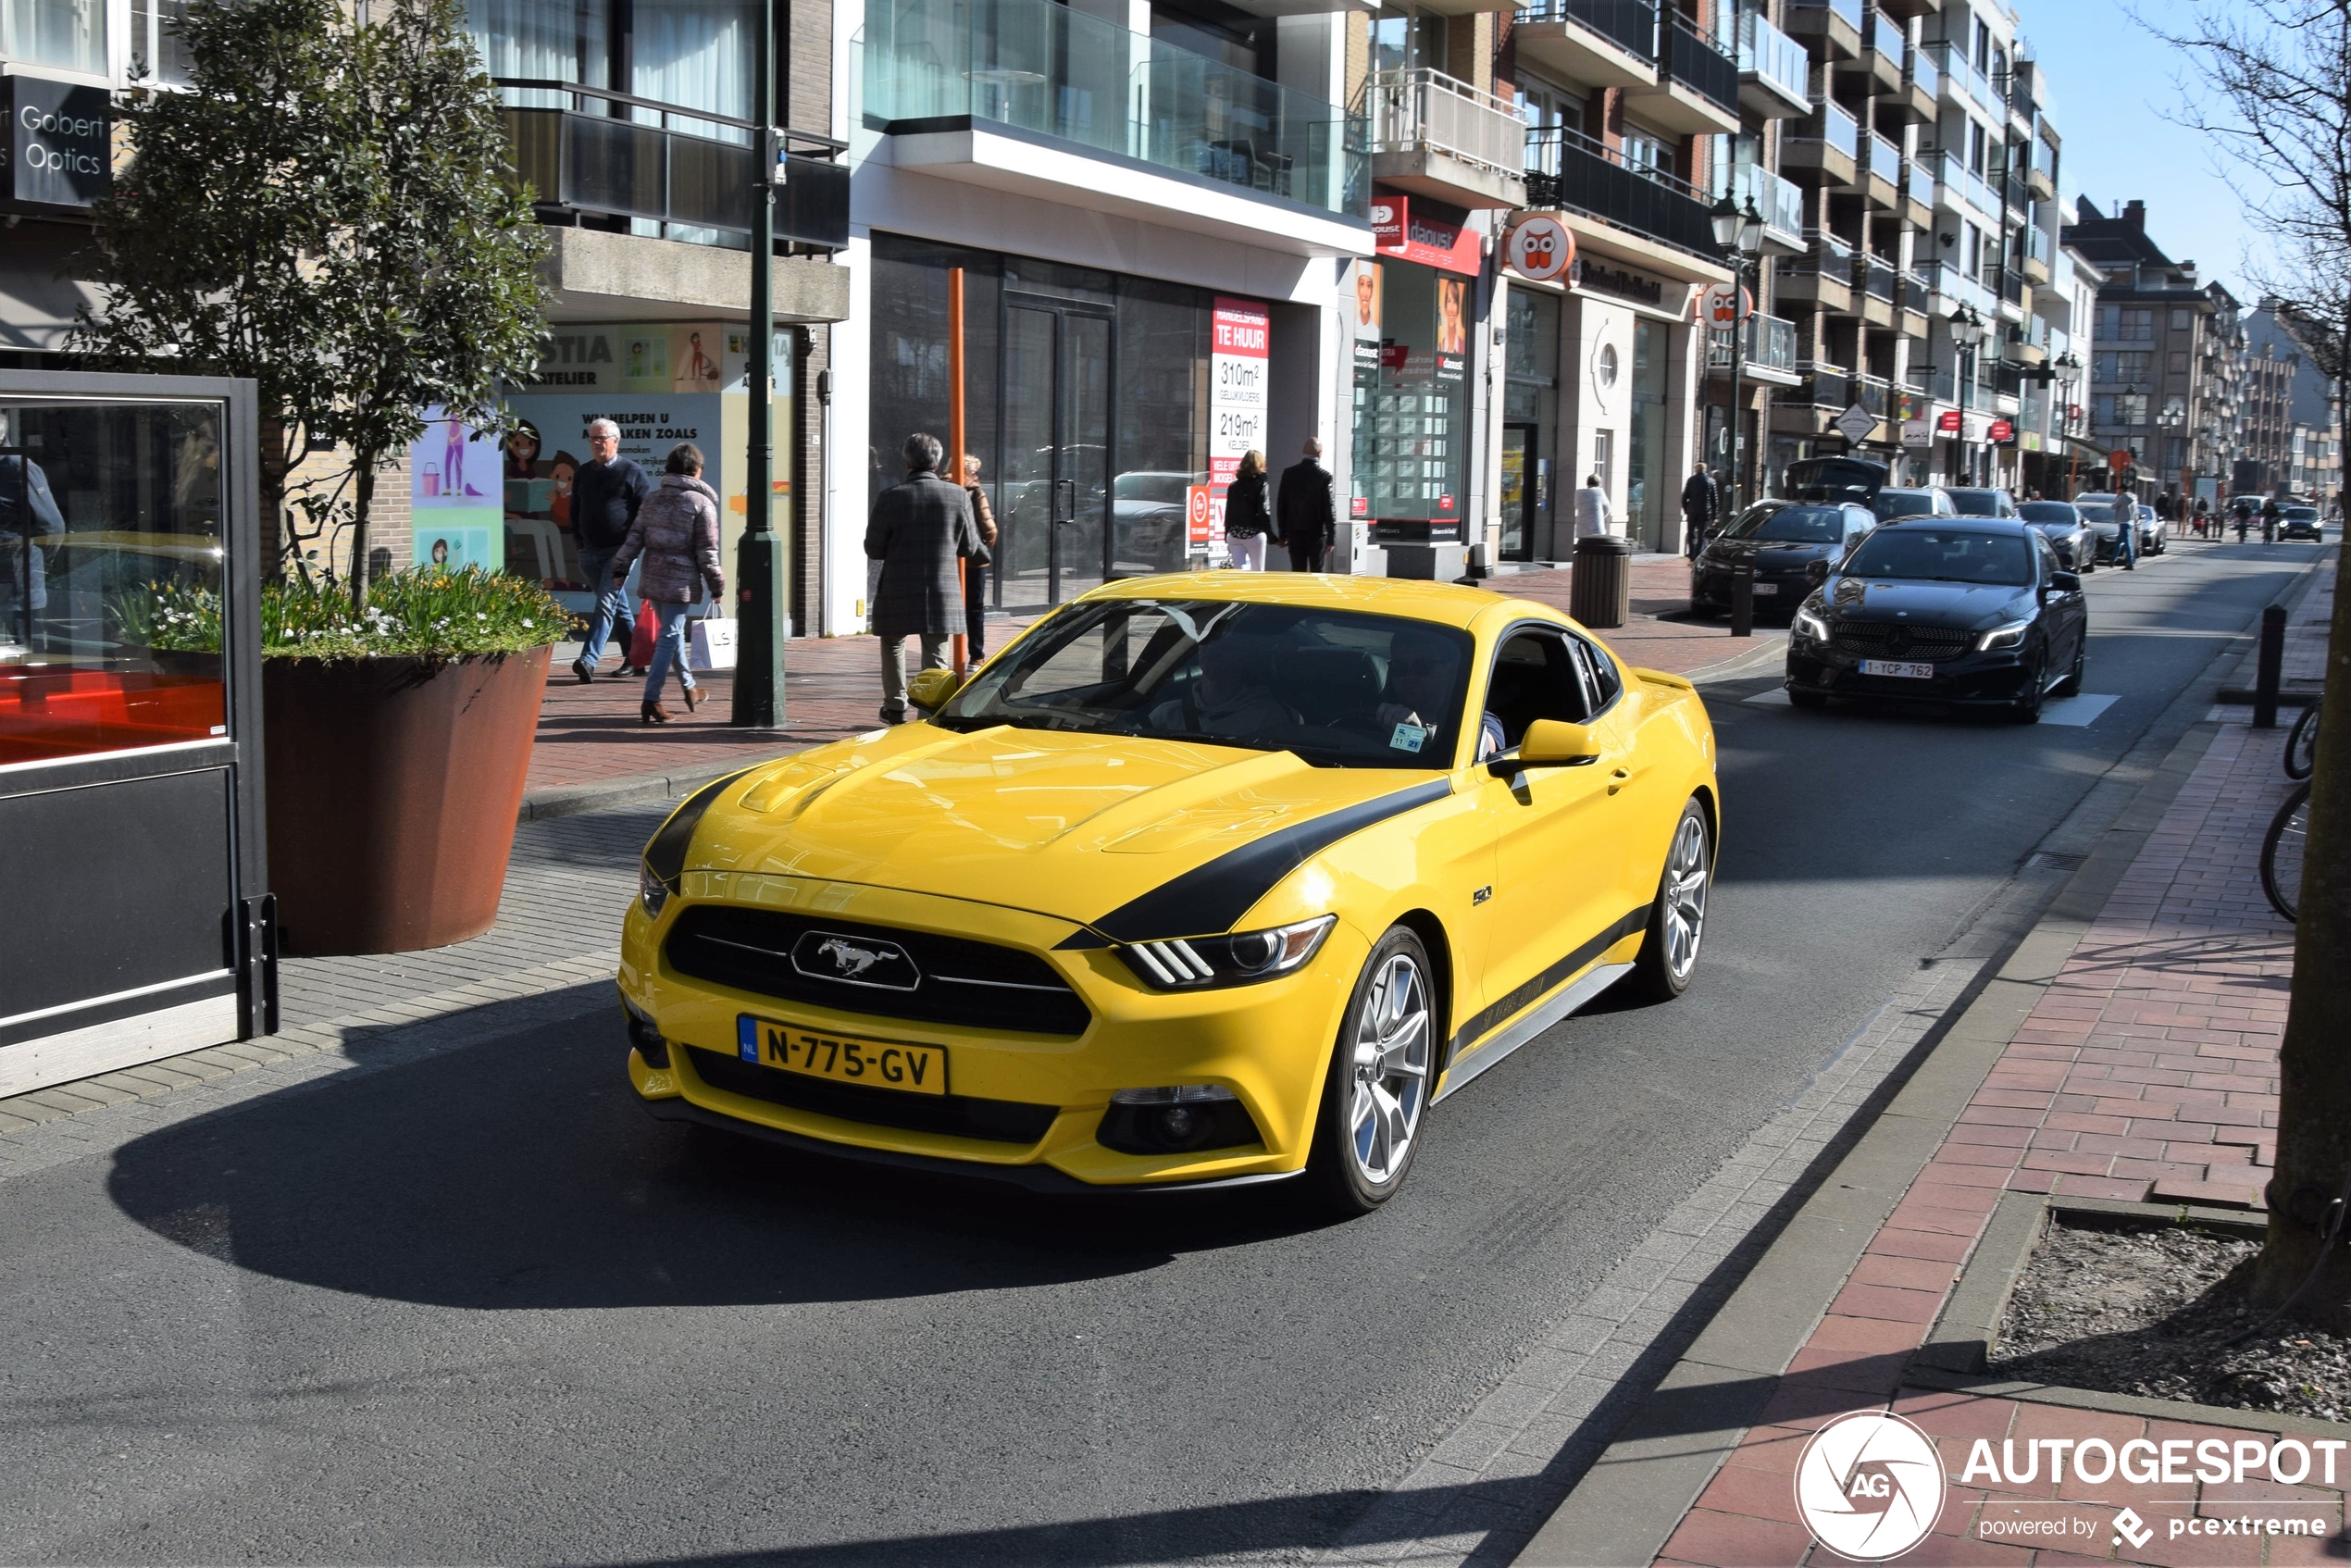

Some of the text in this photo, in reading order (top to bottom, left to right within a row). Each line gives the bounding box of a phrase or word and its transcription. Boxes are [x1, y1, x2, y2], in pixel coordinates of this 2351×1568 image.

[20, 106, 105, 138] Gobert
[26, 143, 100, 174] Optics
[1372, 225, 1400, 233] oust
[1410, 220, 1453, 249] daoust
[1216, 324, 1265, 350] TE HUUR
[538, 335, 613, 364] STIA
[660, 414, 669, 424] U
[621, 428, 697, 440] AKEN ZOALS
[1868, 662, 1931, 677] 1-YCP-762
[1408, 740, 1419, 749] 21
[743, 1043, 756, 1055] NL
[767, 1028, 928, 1086] N-775-GV
